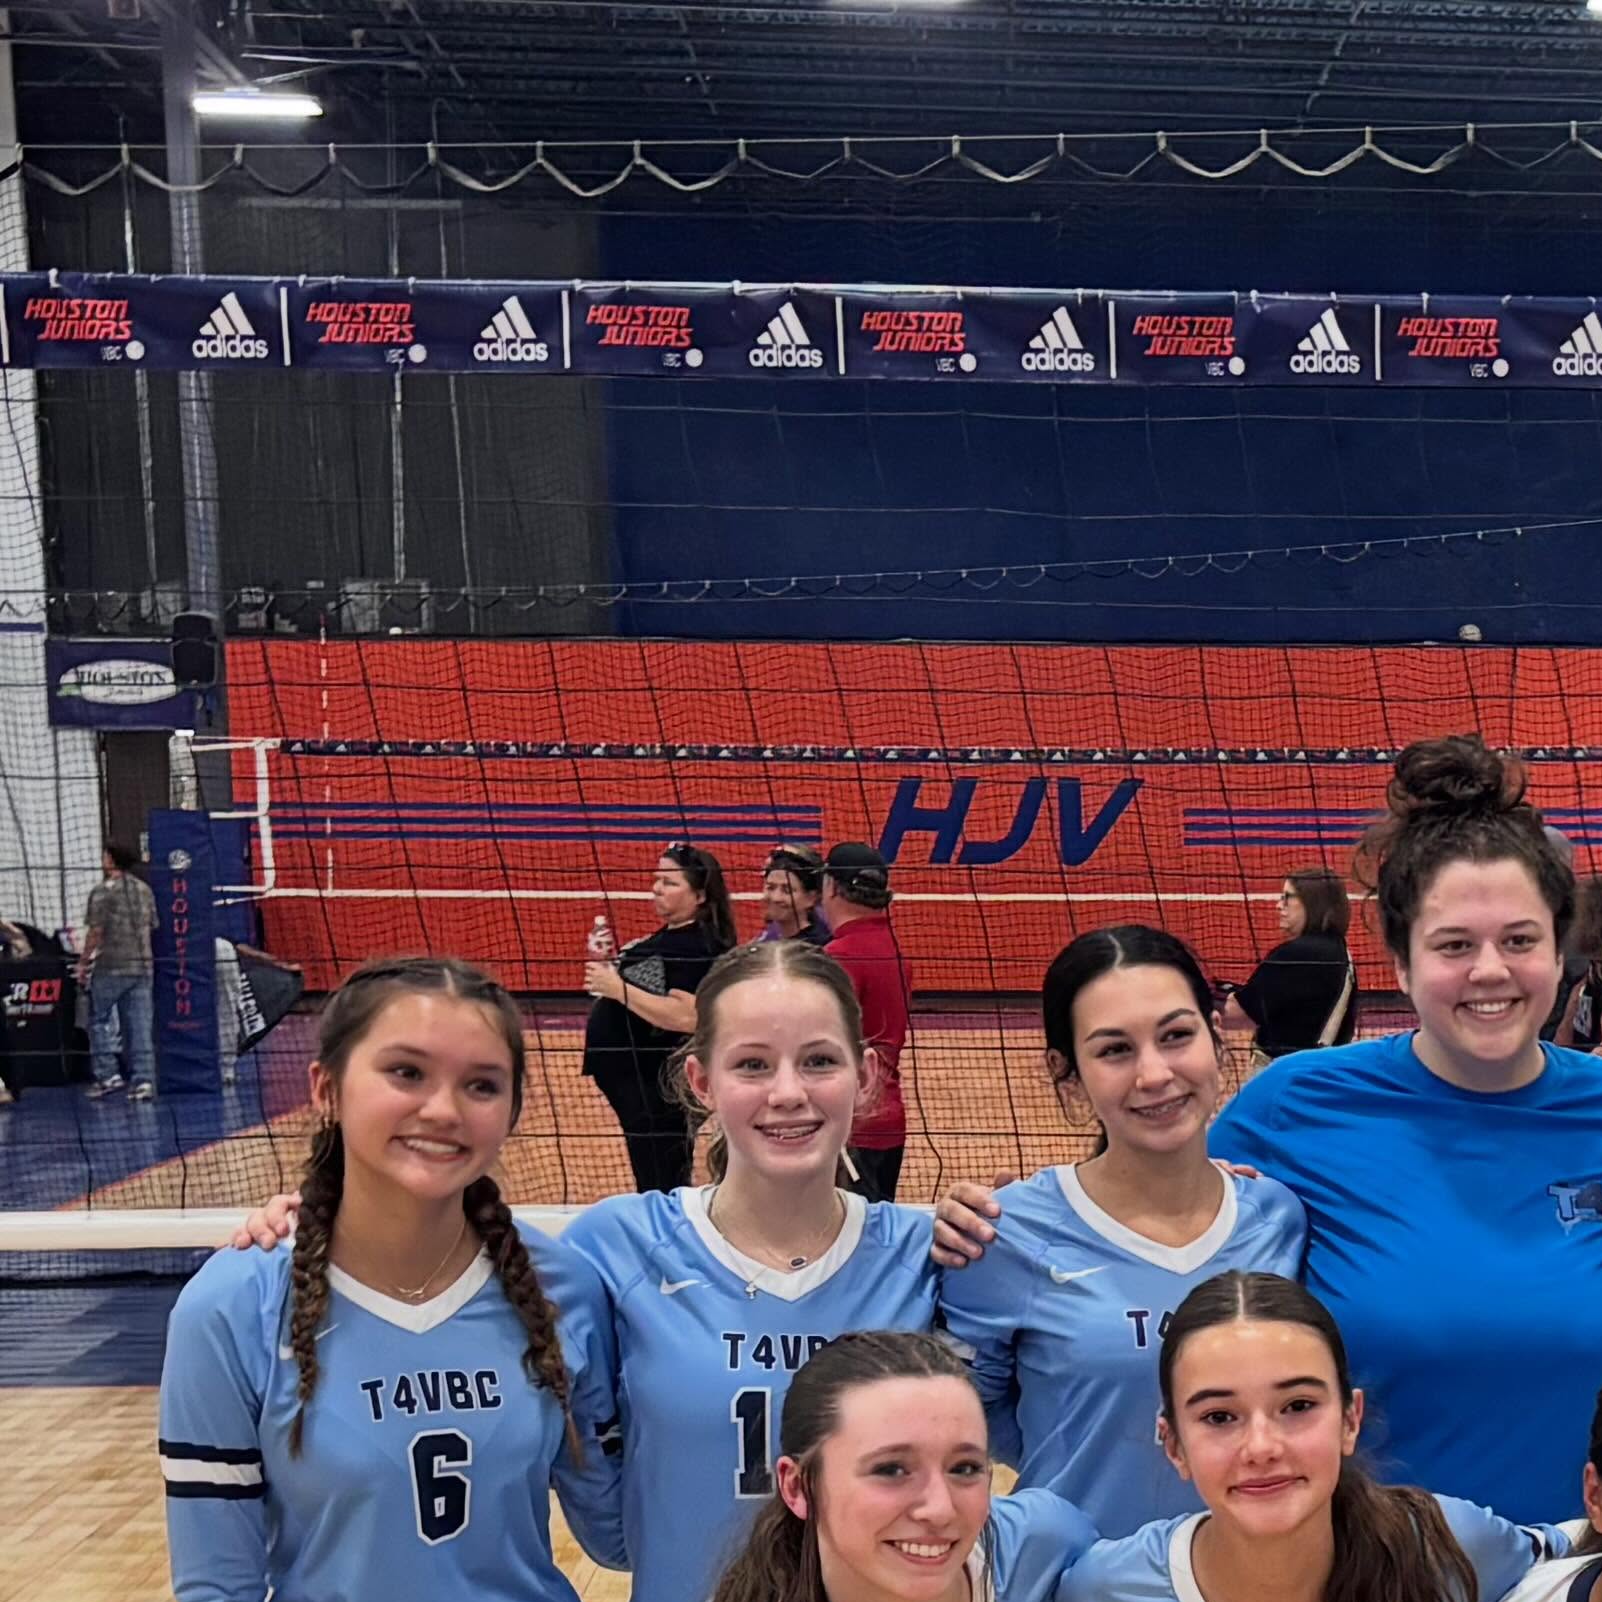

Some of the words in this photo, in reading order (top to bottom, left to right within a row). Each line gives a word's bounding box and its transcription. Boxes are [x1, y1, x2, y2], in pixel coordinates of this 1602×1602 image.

[24, 298, 129, 319] HOUSTON
[305, 302, 412, 323] HOUSTON
[586, 304, 690, 326] HOUSTON
[37, 319, 133, 340] JUNIORS
[861, 311, 963, 331] HOUSTON
[1133, 315, 1234, 335] HOUSTON
[1397, 317, 1498, 337] HOUSTON
[318, 323, 415, 344] JUNIORS
[598, 327, 693, 347] JUNIORS
[872, 332, 966, 352] JUNIORS
[192, 335, 269, 359] adidas
[473, 338, 549, 361] adidas
[749, 344, 823, 368] adidas
[1021, 348, 1095, 371] adidas
[1290, 351, 1361, 374] adidas
[877, 776, 1145, 866] HJV
[360, 1369, 503, 1422] T4VBC
[408, 1428, 472, 1546] 6
